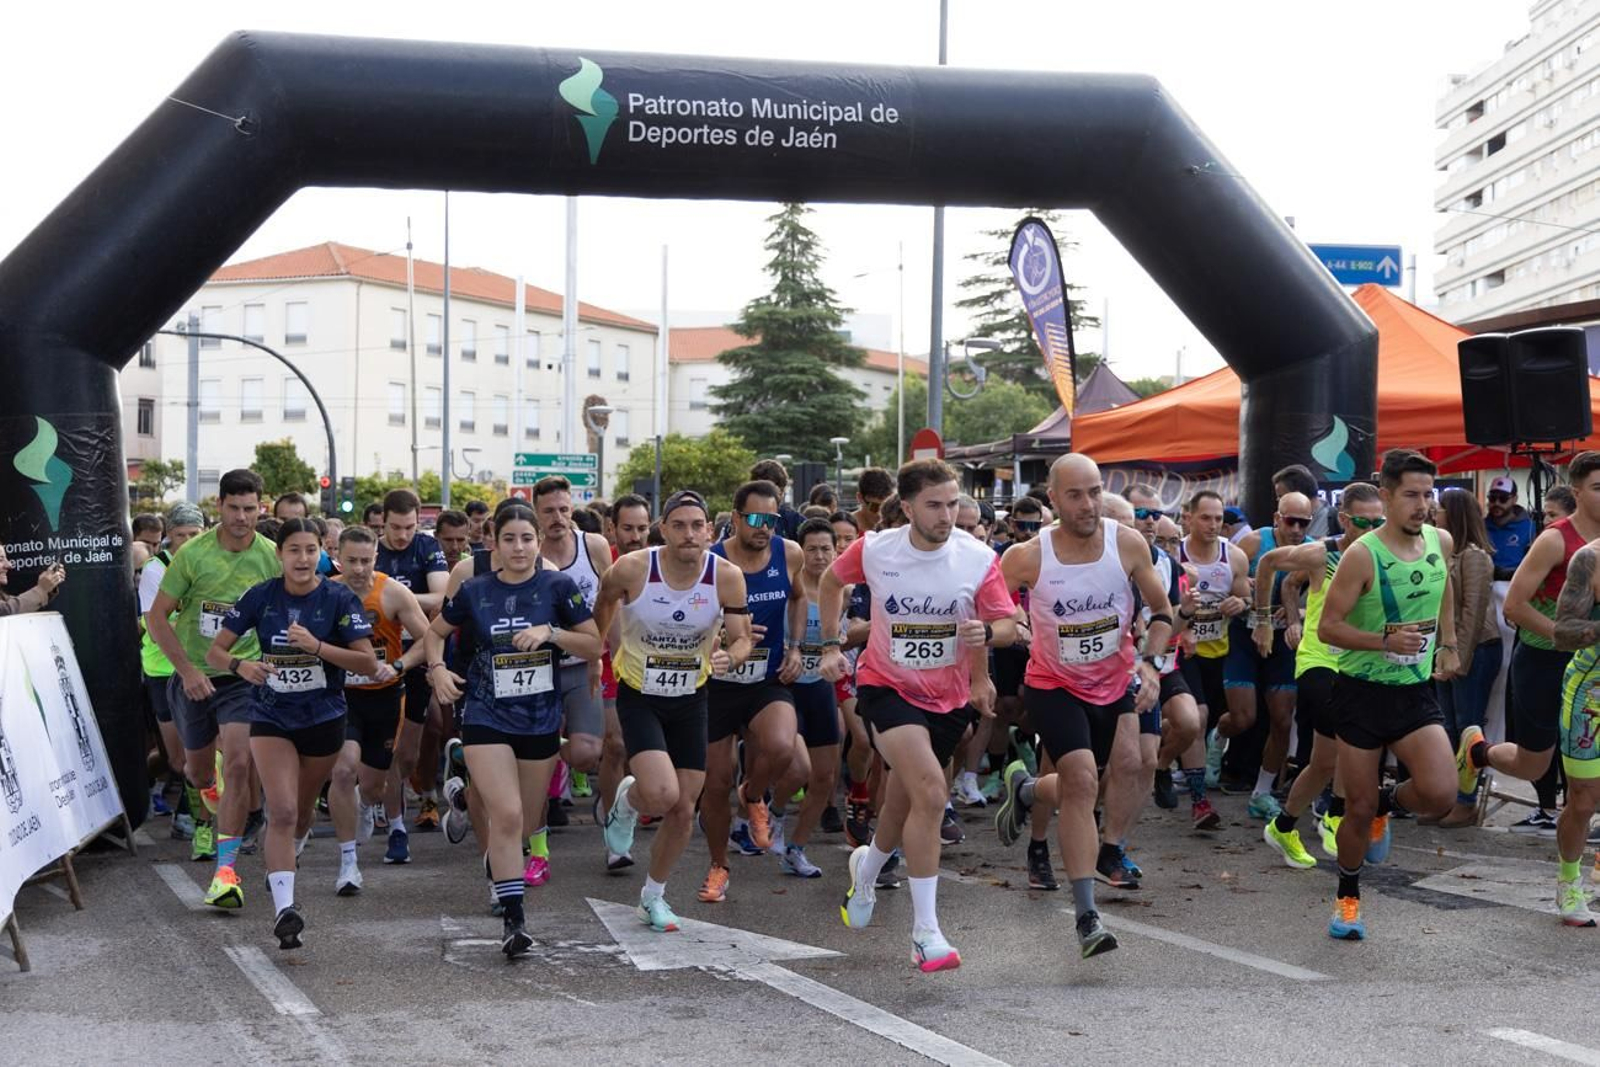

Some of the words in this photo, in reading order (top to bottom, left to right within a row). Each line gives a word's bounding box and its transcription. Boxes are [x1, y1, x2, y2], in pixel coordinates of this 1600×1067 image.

[628, 93, 744, 118] Patronato
[751, 97, 863, 127] Municipal
[870, 103, 899, 123] de
[628, 120, 738, 148] Deportes
[744, 125, 774, 147] de
[780, 126, 838, 149] Jaén
[4, 541, 44, 553] onato
[48, 534, 110, 551] Municipal
[111, 534, 123, 546] de
[11, 553, 57, 571] eporte
[63, 551, 81, 564] de
[85, 549, 113, 563] Jaén
[747, 590, 787, 604] ASIERRA
[898, 595, 958, 617] Salud
[1065, 592, 1116, 618] Salud
[490, 616, 533, 635] 25
[904, 641, 945, 659] 263
[1079, 636, 1104, 655] 55
[278, 669, 314, 684] 432
[513, 669, 536, 686] 47
[731, 661, 756, 676] 01
[656, 671, 688, 687] 441
